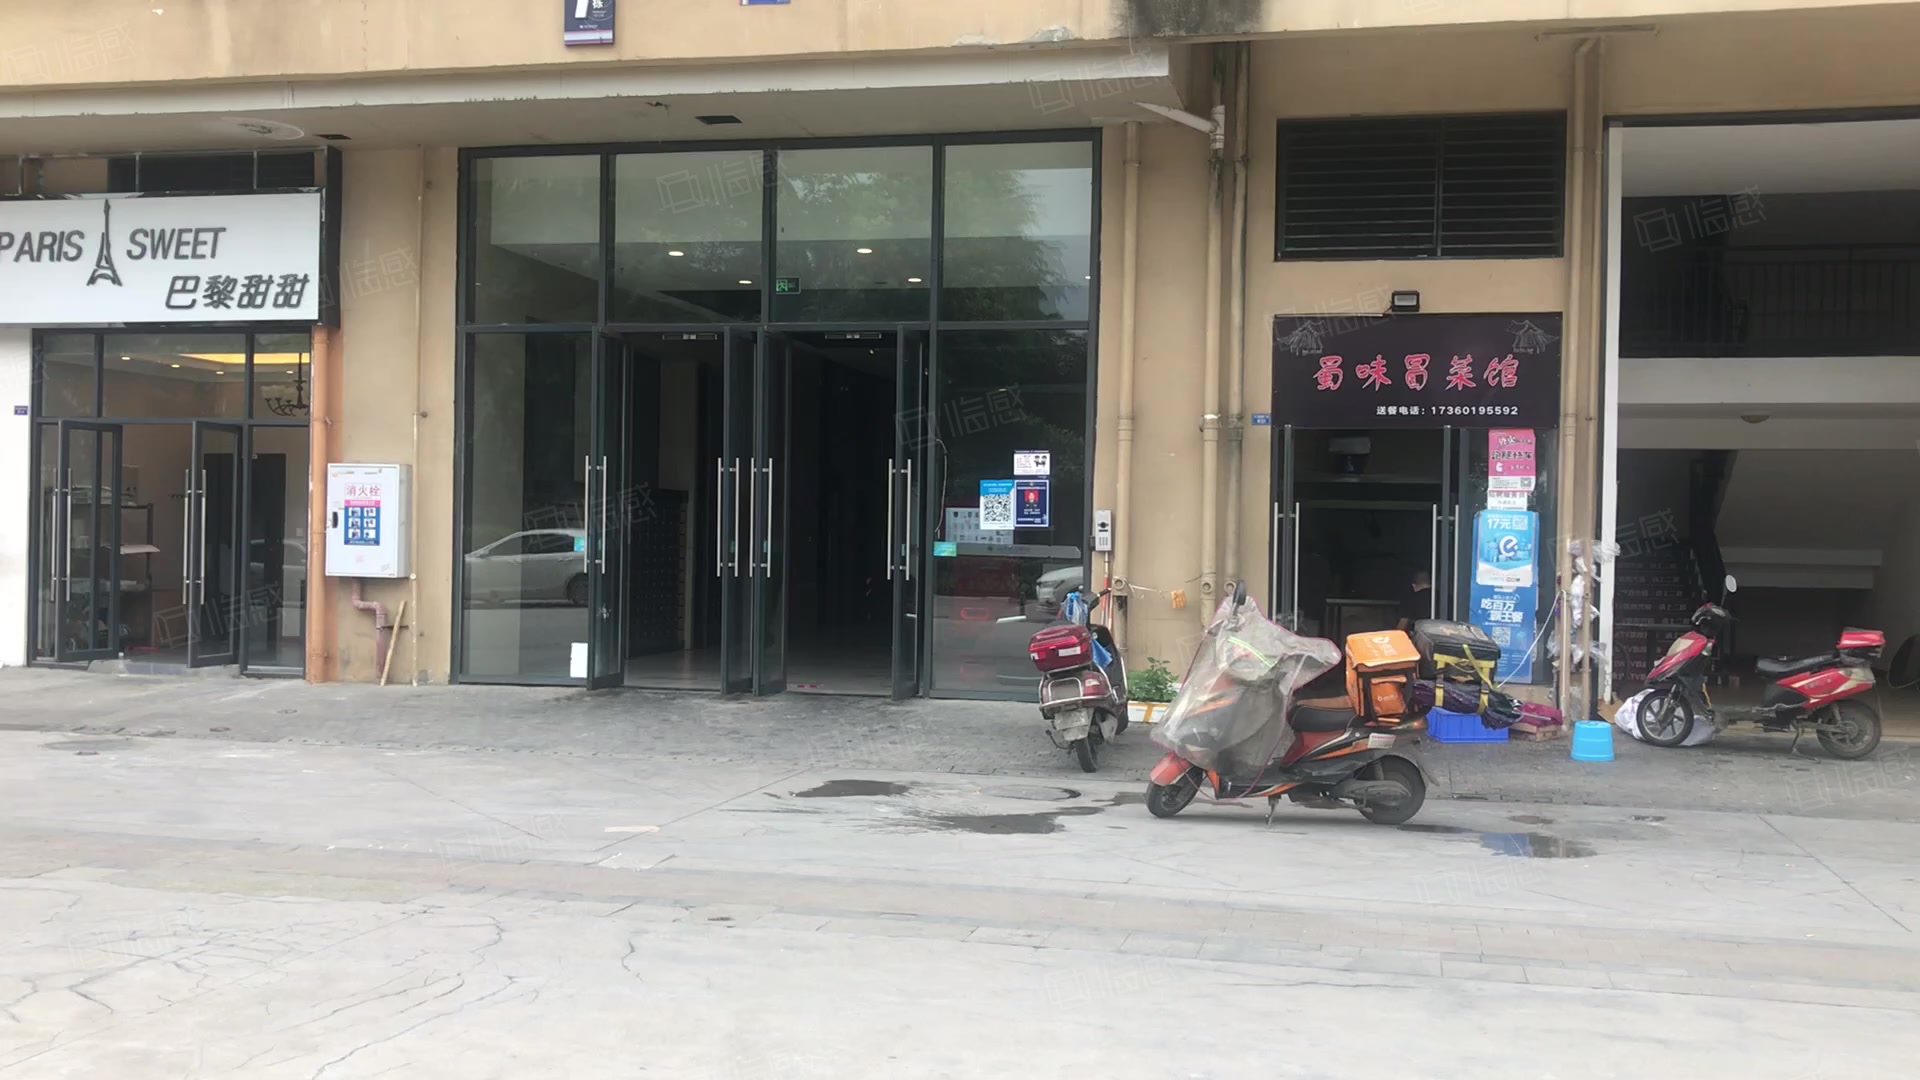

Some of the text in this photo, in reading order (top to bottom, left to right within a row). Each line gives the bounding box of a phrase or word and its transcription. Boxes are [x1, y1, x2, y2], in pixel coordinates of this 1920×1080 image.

[0, 227, 227, 263] PARIS SWEET
[165, 273, 310, 310] 巴黎甜甜
[1313, 353, 1519, 391] 蜀味冒菜馆
[346, 484, 381, 497] 消火栓
[1487, 517, 1512, 529] 17元
[1481, 598, 1516, 612] 吃百万
